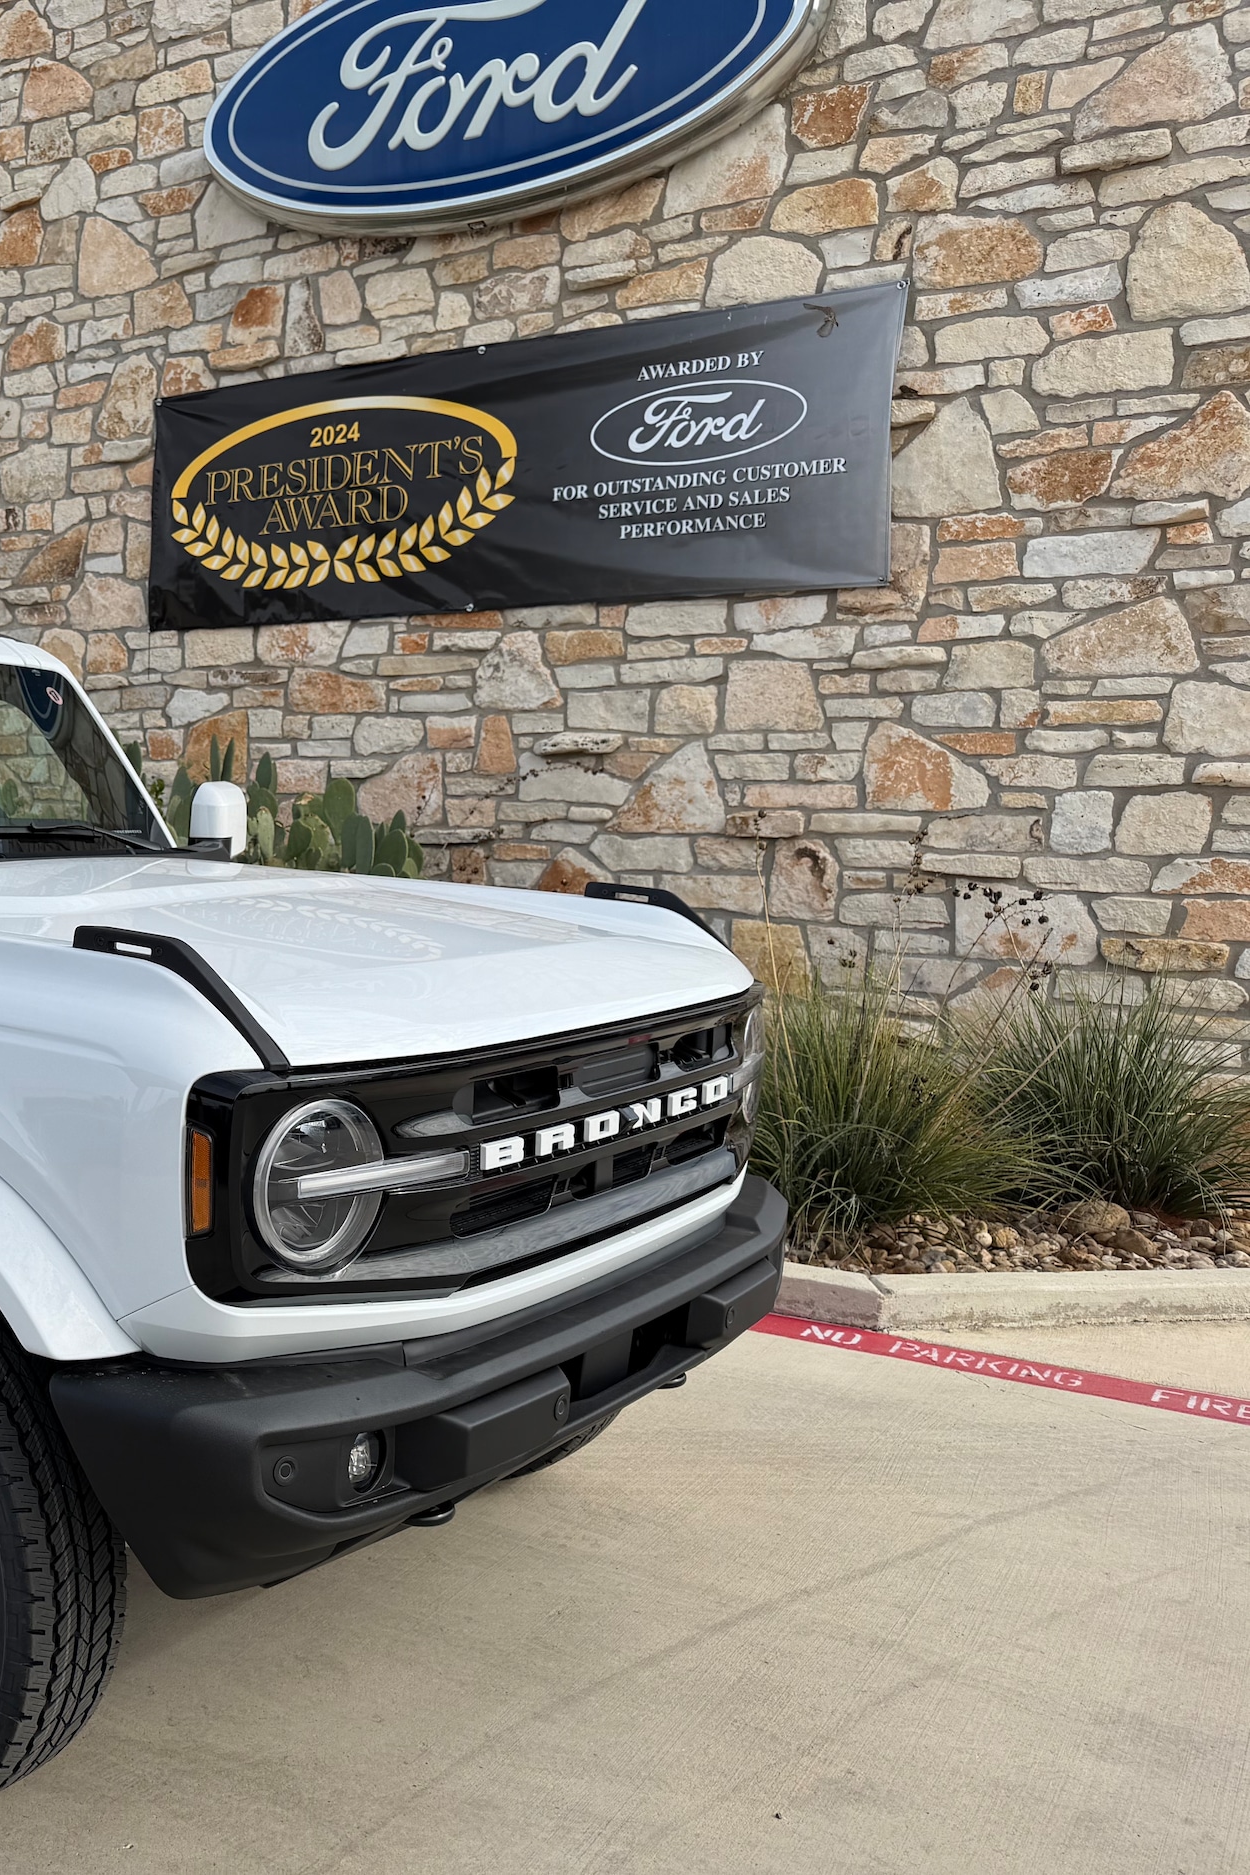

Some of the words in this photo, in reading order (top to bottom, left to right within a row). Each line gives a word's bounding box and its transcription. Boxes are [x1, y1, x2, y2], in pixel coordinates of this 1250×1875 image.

[307, 0, 646, 171] Ford
[636, 355, 731, 382] AWARDED
[736, 350, 764, 368] BY
[309, 421, 361, 448] 2024
[627, 391, 766, 454] Ford
[204, 435, 485, 506] PRESIDENT'S
[552, 484, 588, 502] FOR
[593, 470, 727, 497] OUTSTANDING
[732, 457, 847, 483] CUSTOMER
[258, 484, 410, 535] AWARD
[598, 493, 677, 520] SERVICE
[682, 493, 724, 512] AND
[728, 486, 790, 506] SALES
[619, 513, 767, 540] PERFORMANCE
[479, 1075, 728, 1171] BRONCO
[800, 1325, 862, 1345] NO
[888, 1340, 1084, 1388] PARKING
[1151, 1389, 1250, 1420] FIRE
